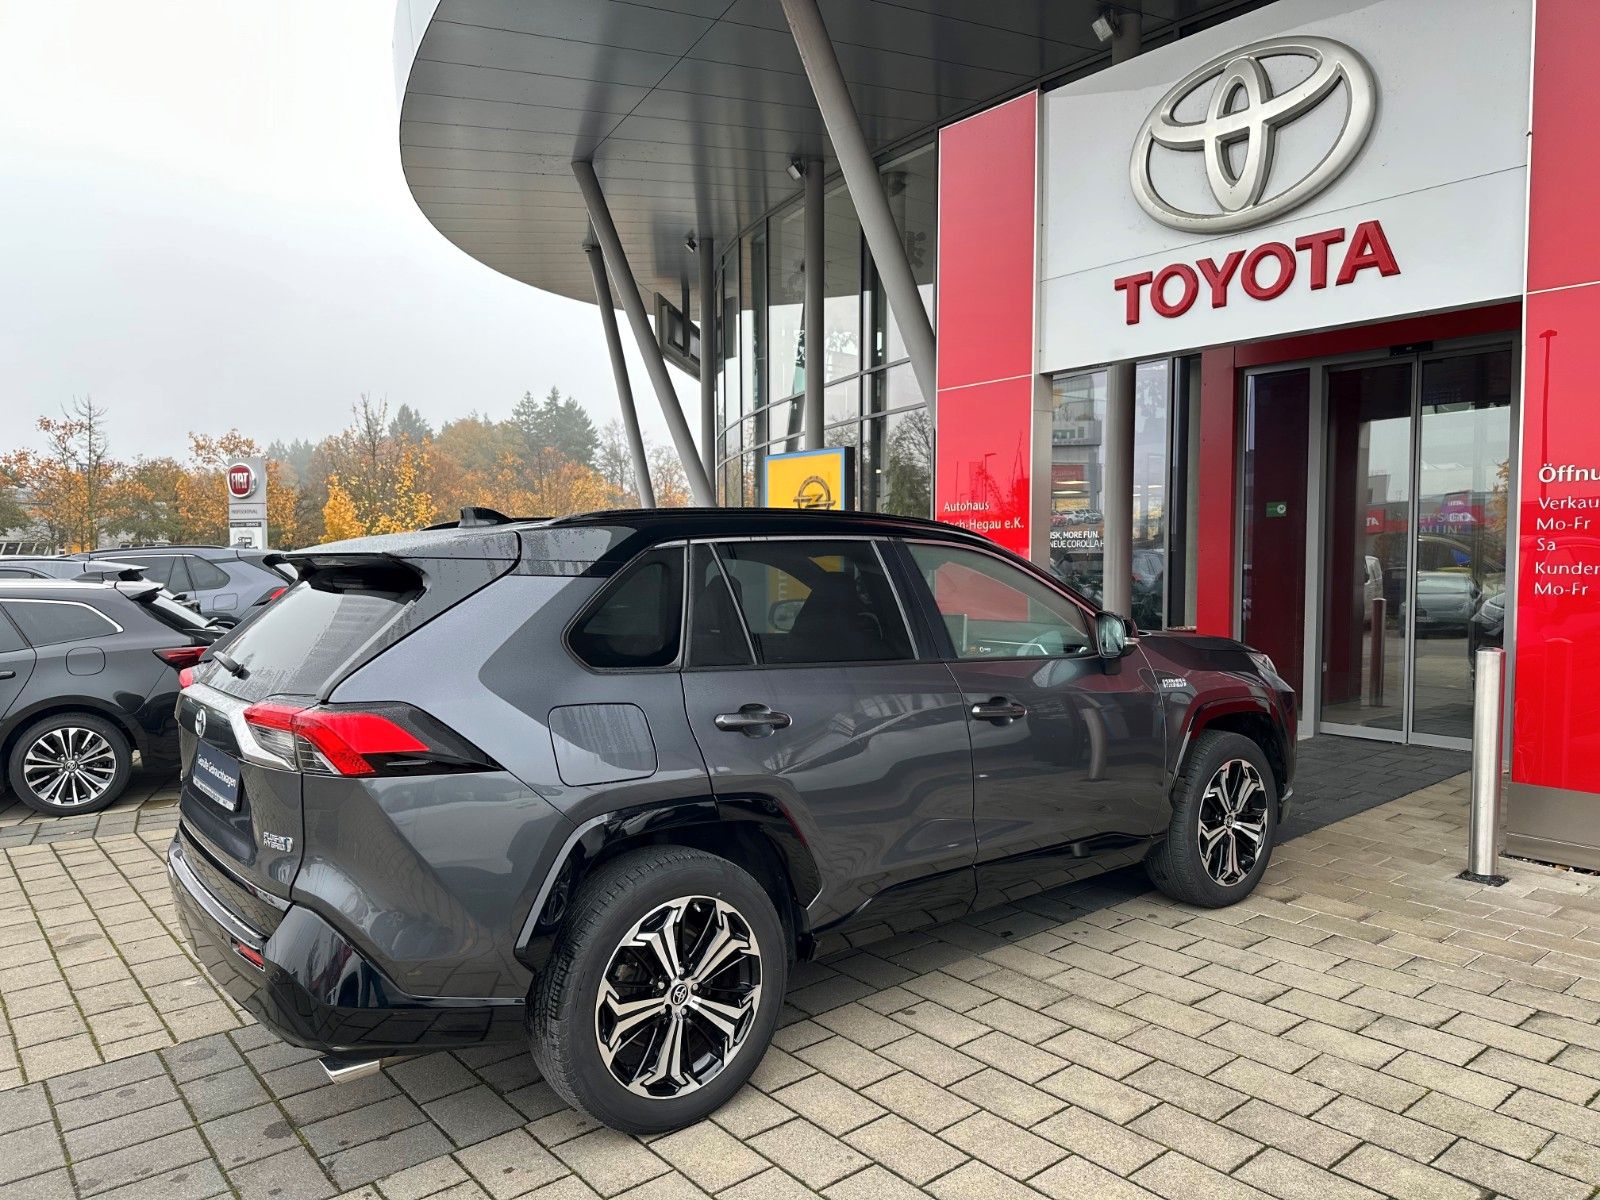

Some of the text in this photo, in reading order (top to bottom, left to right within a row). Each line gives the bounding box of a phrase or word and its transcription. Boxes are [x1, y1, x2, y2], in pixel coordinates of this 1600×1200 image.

[1114, 219, 1401, 325] TOYOTA
[1538, 463, 1600, 483] Öffnu
[230, 472, 249, 489] FIAT
[943, 501, 990, 512] Autohaus
[1538, 495, 1600, 510] Verkau
[1004, 517, 1025, 529] e.K.
[1536, 516, 1592, 531] Mo-Fr
[1063, 530, 1083, 539] MORE
[1083, 530, 1100, 539] FUN.
[1067, 539, 1100, 548] COROLLA
[1536, 537, 1556, 551] Sa
[1534, 582, 1589, 596] Mo-Fr
